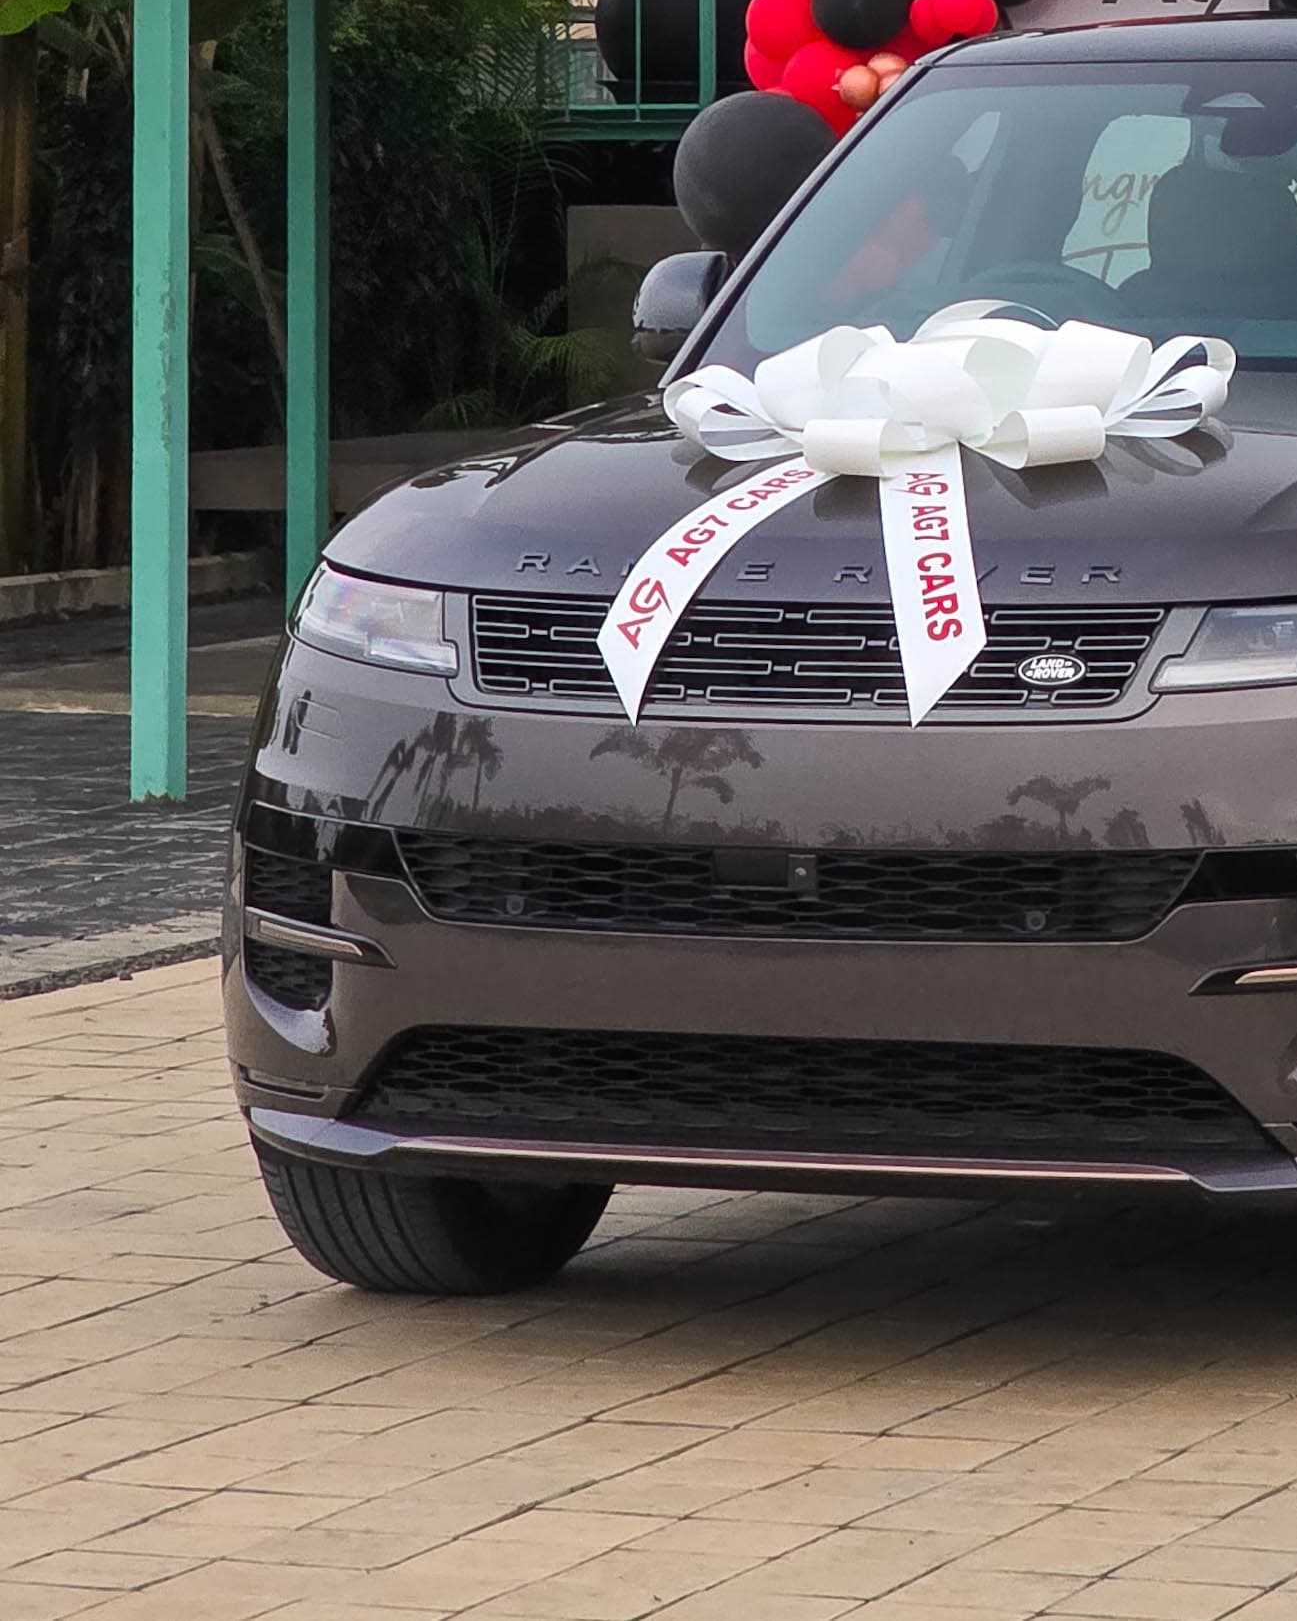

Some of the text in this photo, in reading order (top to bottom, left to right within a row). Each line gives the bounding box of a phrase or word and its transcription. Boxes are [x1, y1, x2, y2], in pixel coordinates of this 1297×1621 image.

[666, 514, 729, 567] AG7
[726, 468, 816, 511] CARS
[911, 506, 950, 540] AG7
[515, 550, 1122, 585] RAE RER
[917, 552, 963, 642] CARS
[1030, 658, 1065, 669] LAND
[1032, 667, 1076, 679] ROVER
